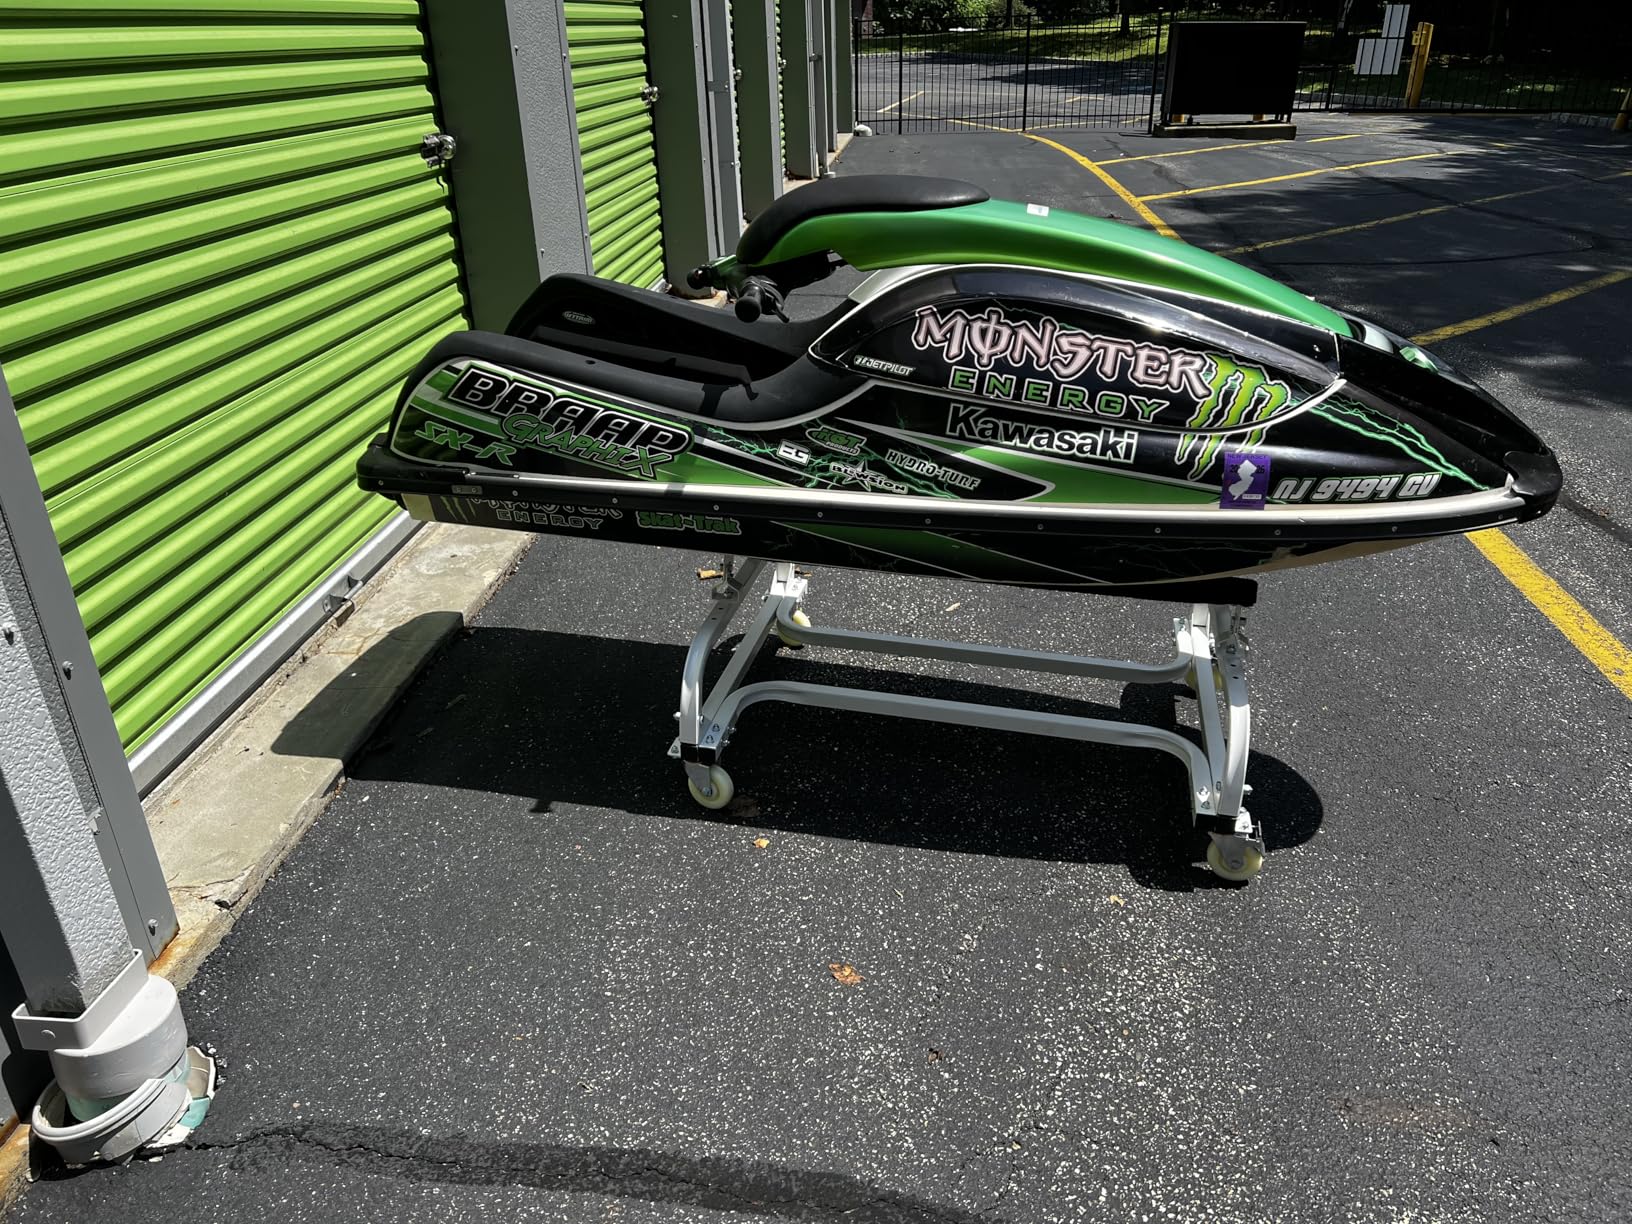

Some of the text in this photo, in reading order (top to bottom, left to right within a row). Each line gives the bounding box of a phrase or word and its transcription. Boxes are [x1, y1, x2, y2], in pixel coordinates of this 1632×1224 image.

[866, 358, 914, 375] JETPILOT
[911, 306, 1215, 400] MONSTER
[448, 368, 690, 452] BRAAP
[948, 366, 1170, 422] ENERGY
[414, 420, 518, 467] SX-R
[503, 413, 674, 478] GRAPHIX
[945, 403, 1138, 463] Kawasaki
[885, 449, 981, 490] HYDRO-TURF
[1271, 479, 1316, 501] NJ
[1312, 475, 1402, 501] 9494
[496, 509, 603, 530] ENERGY
